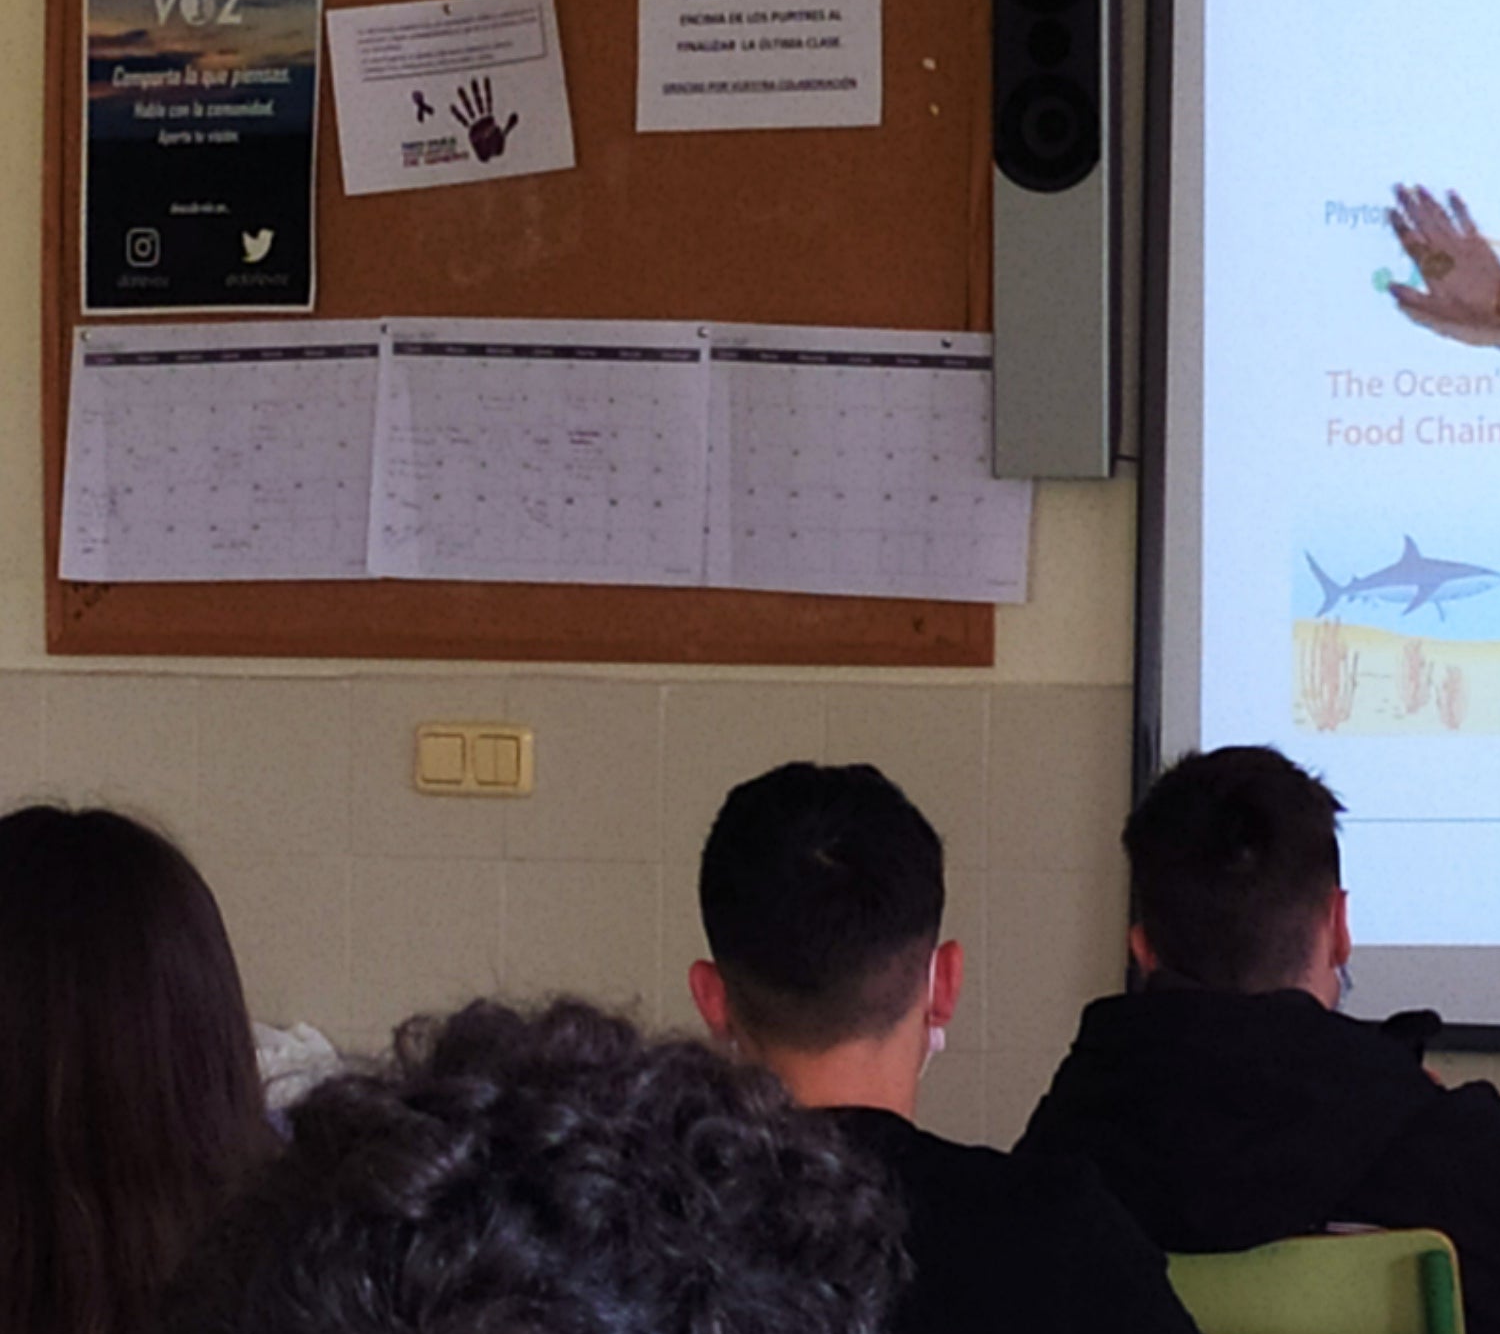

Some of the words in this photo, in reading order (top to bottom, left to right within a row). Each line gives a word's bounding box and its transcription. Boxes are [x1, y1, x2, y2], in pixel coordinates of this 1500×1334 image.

[746, 11, 768, 23] LOS
[1326, 370, 1385, 399] The
[1326, 418, 1404, 446] Food
